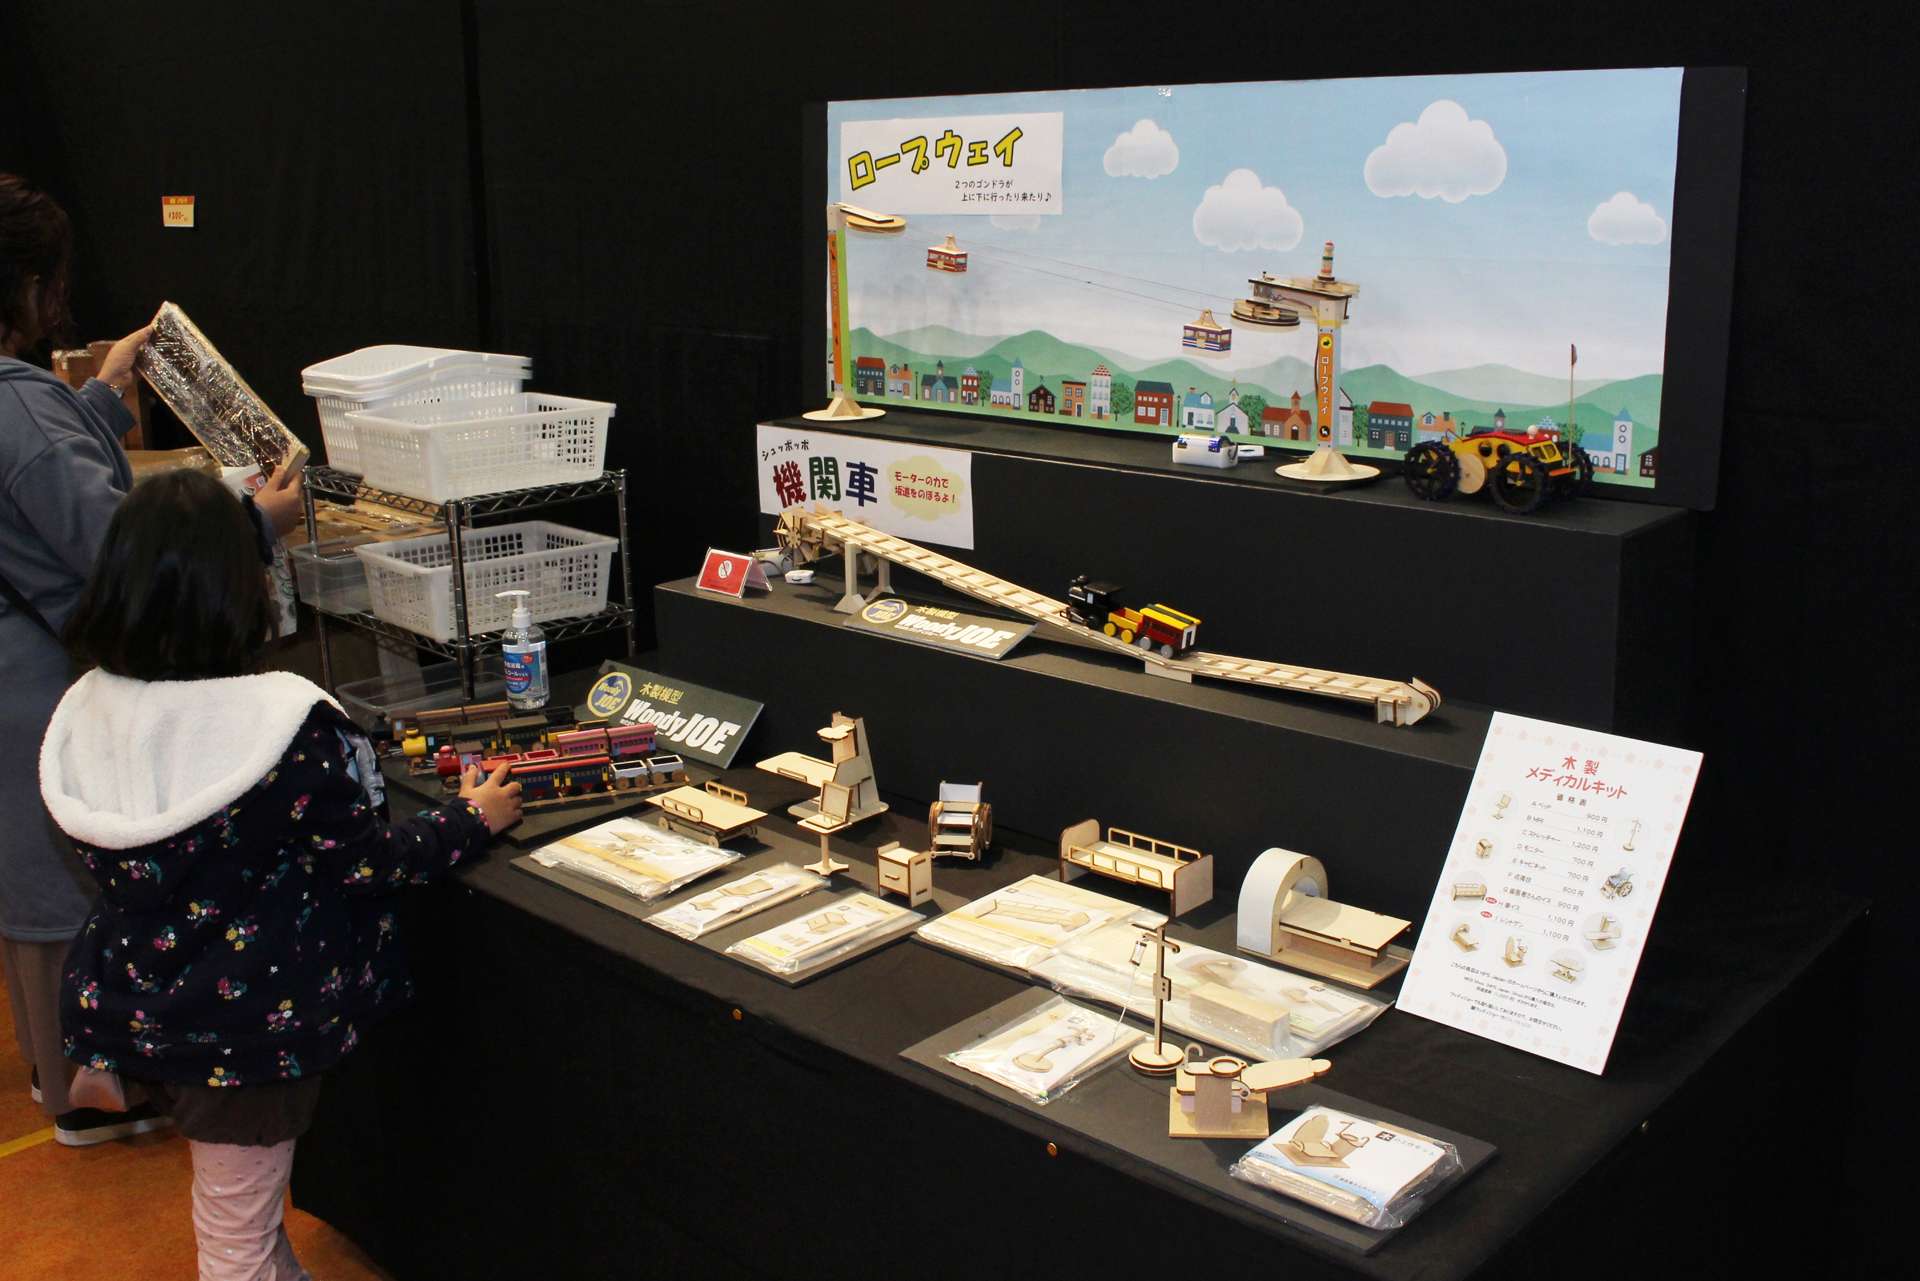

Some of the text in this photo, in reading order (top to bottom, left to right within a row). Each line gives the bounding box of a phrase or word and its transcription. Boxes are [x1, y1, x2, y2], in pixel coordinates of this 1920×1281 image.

[848, 126, 1024, 191] ロープウェイ
[955, 179, 1013, 189] 2つのゴンドラが
[773, 456, 879, 508] 機関車
[895, 471, 948, 488] モーターの力で
[598, 682, 622, 695] Woody
[639, 682, 684, 705] 木製模型
[595, 694, 622, 711] JOE
[1525, 767, 1627, 799] メディカルキット
